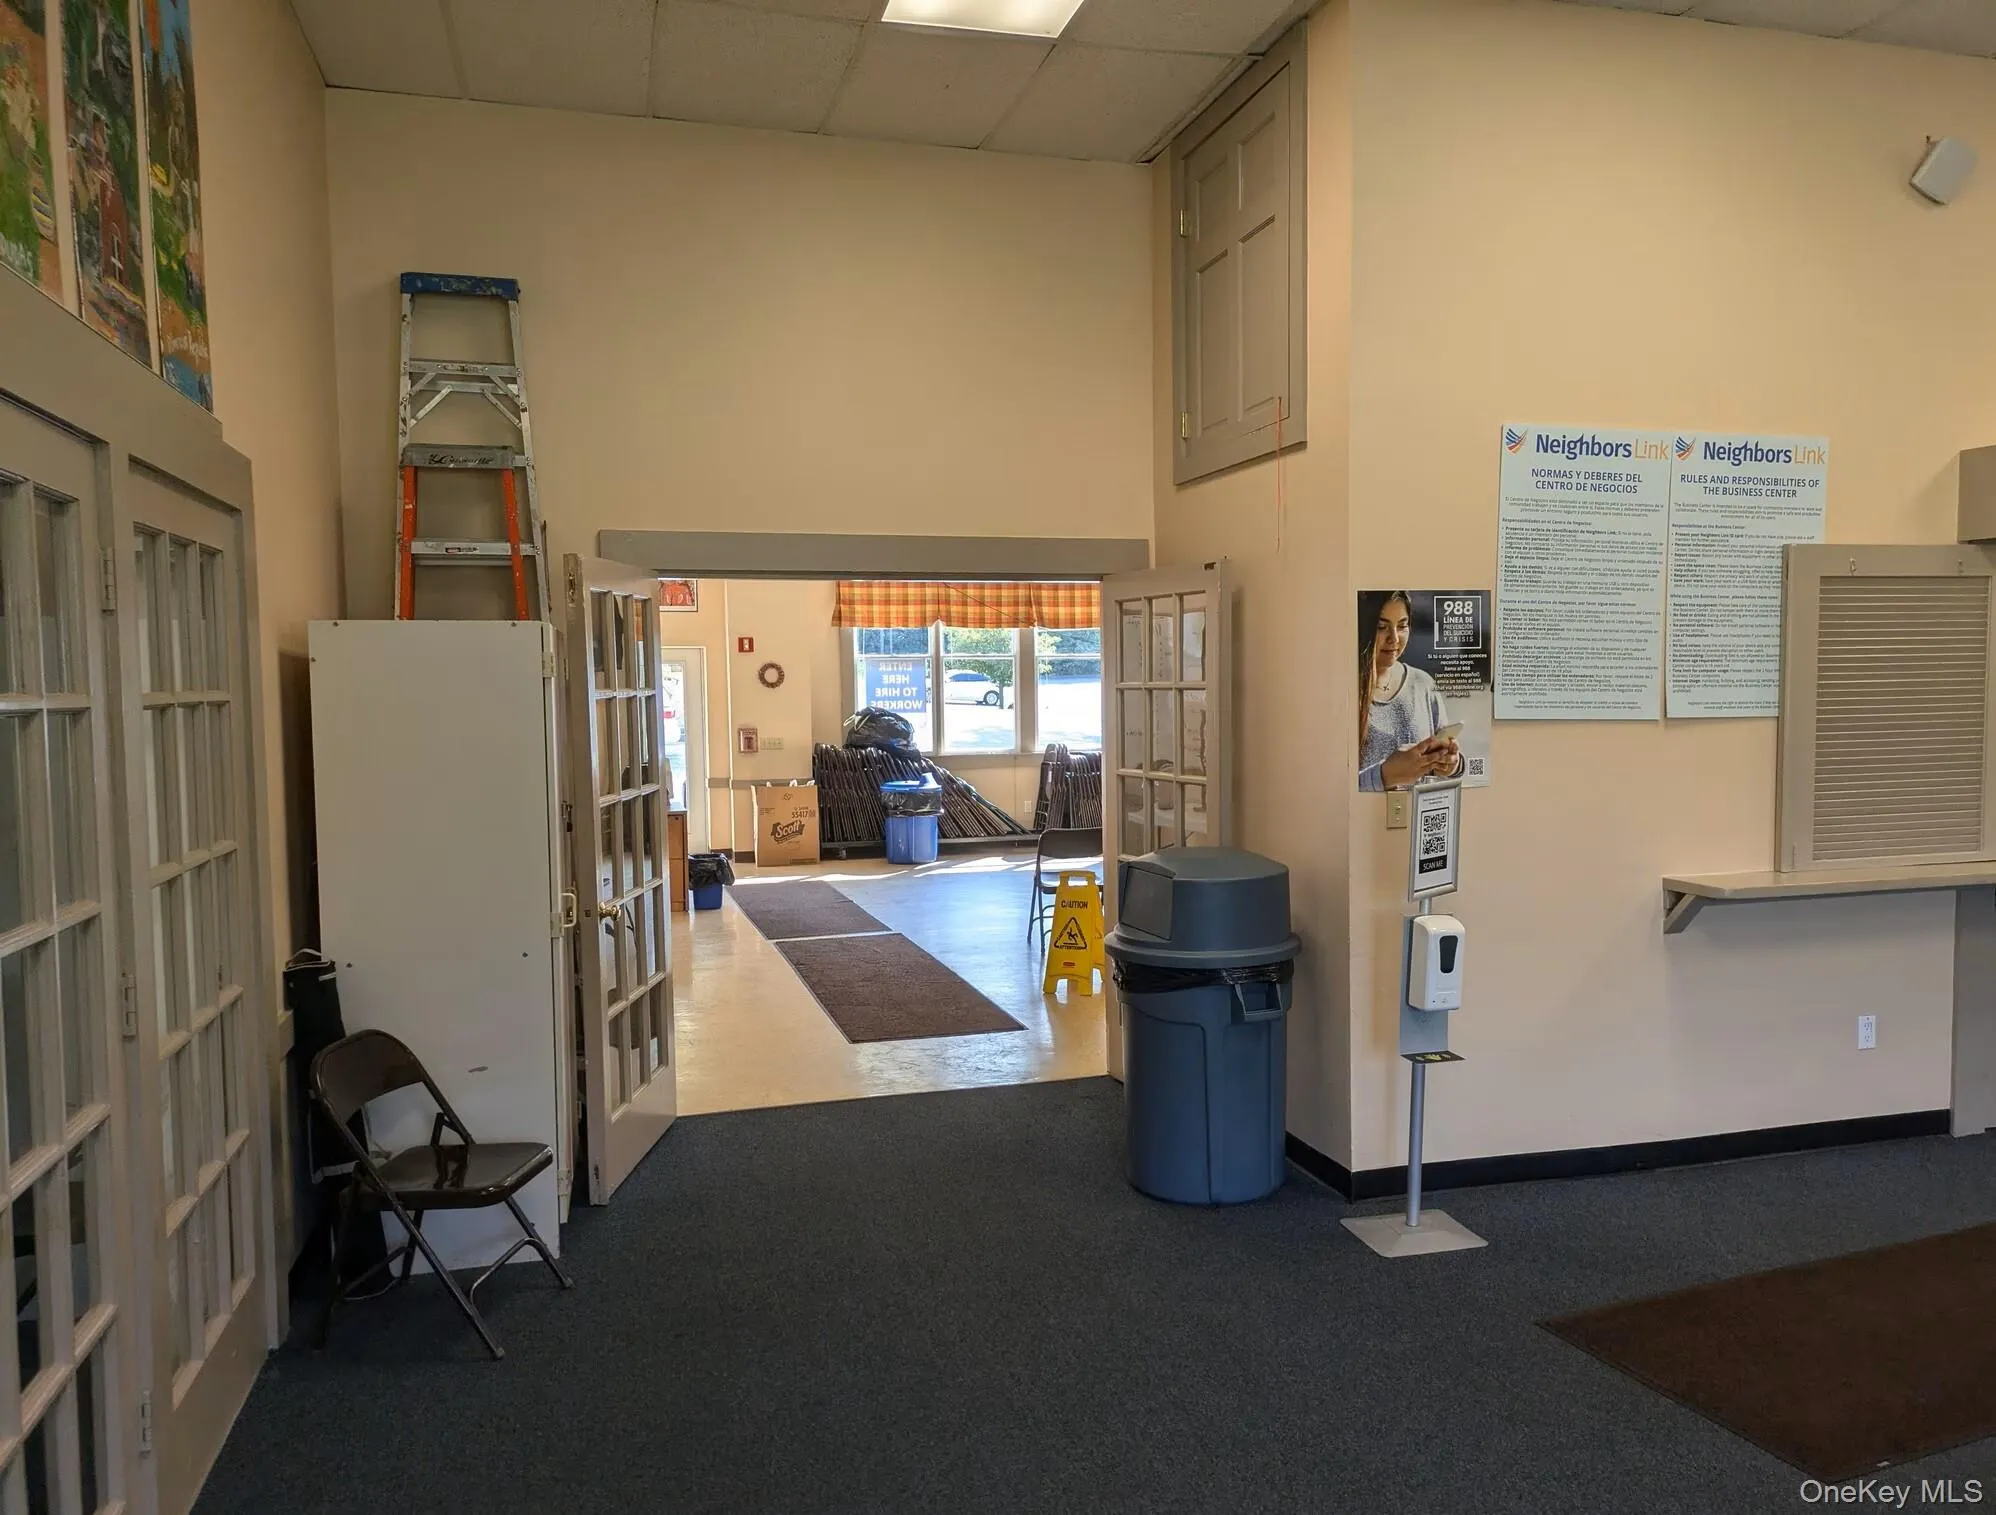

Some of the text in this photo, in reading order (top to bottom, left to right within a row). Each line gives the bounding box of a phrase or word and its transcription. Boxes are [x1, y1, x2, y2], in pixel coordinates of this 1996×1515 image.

[1536, 433, 1669, 460] Neighbors Link
[1703, 440, 1825, 466] Neighbors Link
[1531, 468, 1643, 483] NORMAS Y DEBERES DEL
[1680, 474, 1820, 488] RULES AND RESPONSIBILITIES OF
[1535, 480, 1638, 494] CENTRO DE NEGOCIOS
[1703, 486, 1797, 498] THE BUSINESS CENTER
[1443, 600, 1473, 615] 988
[1443, 615, 1464, 623] LÍNEA
[775, 820, 800, 838] Scott
[1423, 860, 1443, 870] SCAN ME
[1061, 900, 1088, 909] CAUTION
